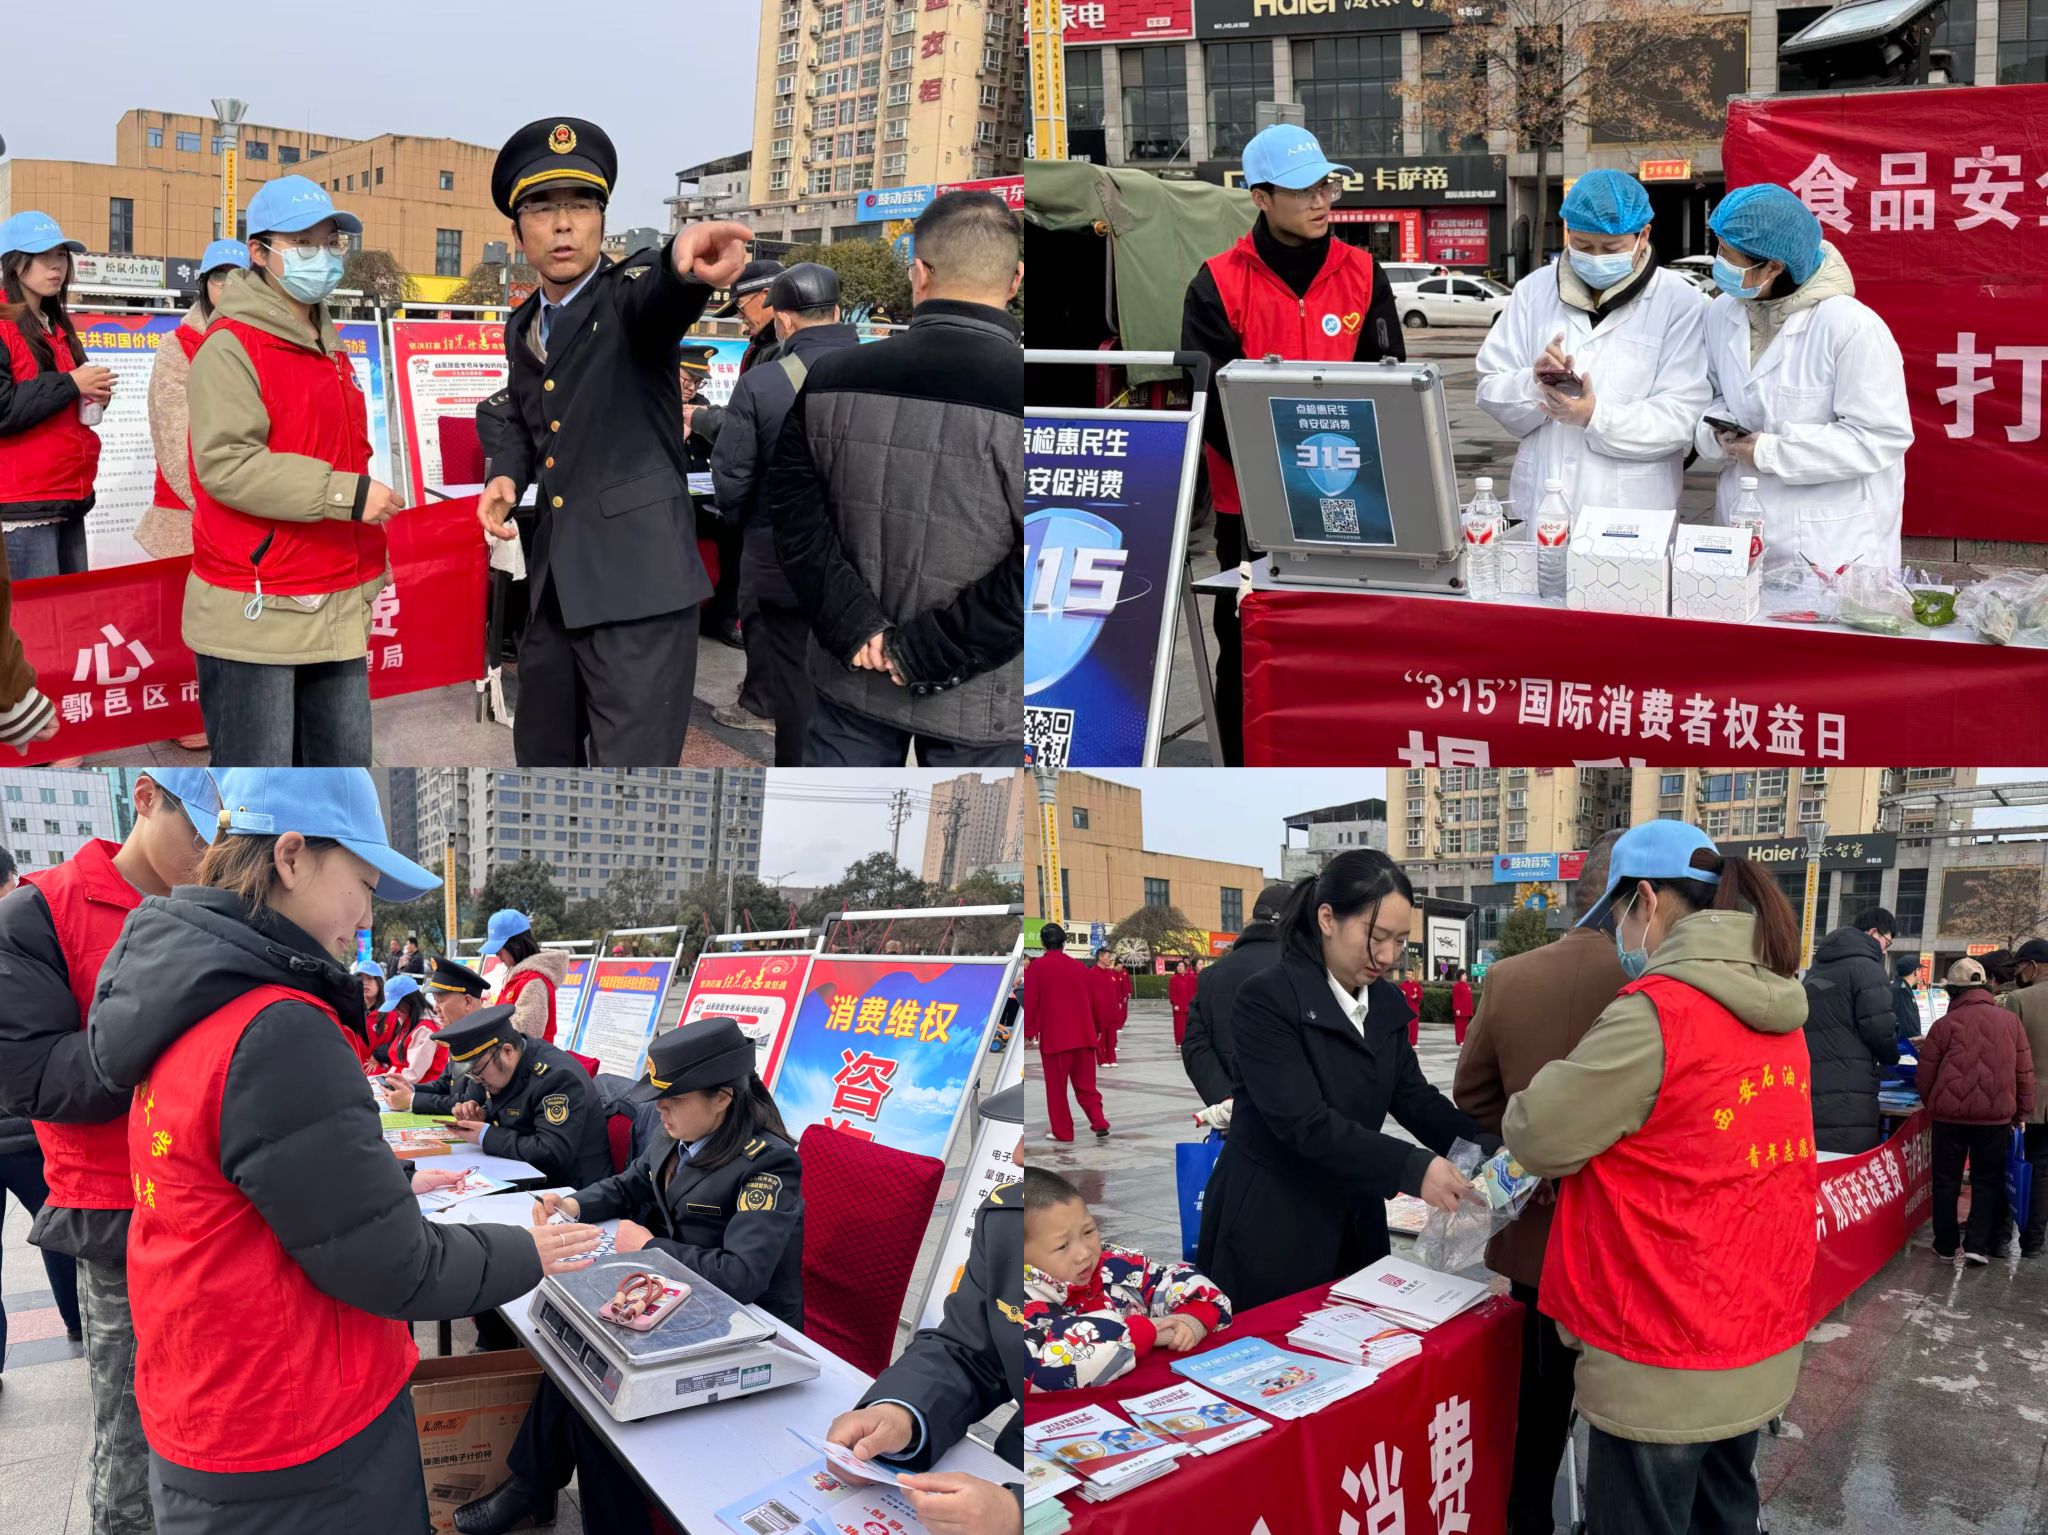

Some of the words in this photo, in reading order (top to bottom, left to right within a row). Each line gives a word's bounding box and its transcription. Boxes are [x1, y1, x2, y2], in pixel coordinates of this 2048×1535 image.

[1372, 166, 1448, 191] 卡萨帝
[878, 189, 926, 207] 鼓动音乐
[1788, 146, 2048, 235] 食品安
[105, 261, 160, 276] 松鼠小食店
[1296, 404, 1349, 416] 点检惠民生
[1299, 418, 1351, 430] 食安促消费
[1296, 444, 1361, 469] 315
[1024, 468, 1124, 499] 安促消费
[1024, 547, 1129, 615] 15
[1511, 856, 1552, 869] 鼓动音乐
[1748, 844, 1798, 862] Haier
[824, 994, 960, 1045] 消费维权
